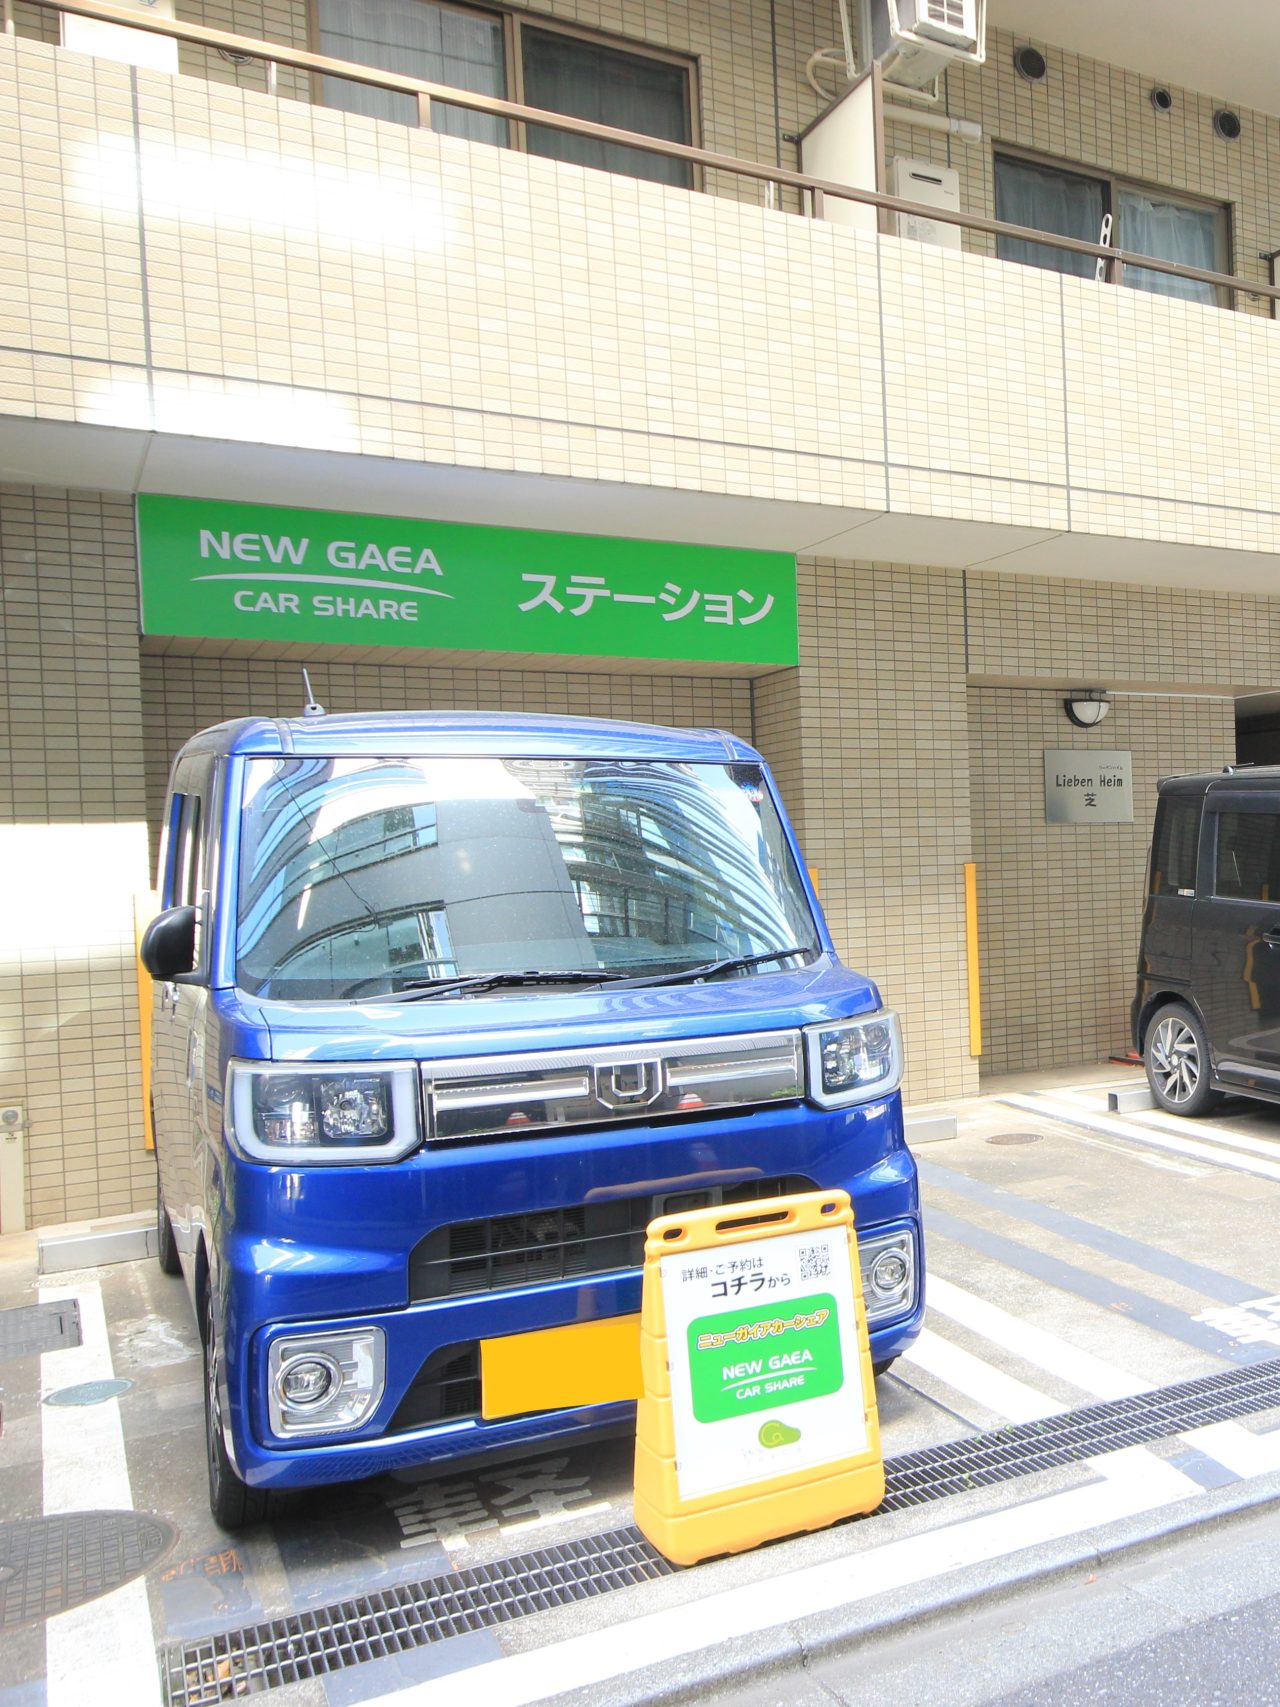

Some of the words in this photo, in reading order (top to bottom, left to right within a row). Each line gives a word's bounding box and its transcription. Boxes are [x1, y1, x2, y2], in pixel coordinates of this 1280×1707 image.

[199, 529, 309, 565] NEW
[326, 541, 443, 576] GAEA
[233, 590, 300, 614] CAR
[312, 595, 418, 621] SHARE
[518, 573, 774, 626] ステーション
[1056, 774, 1093, 788] Lieben
[1099, 774, 1123, 788] Heim
[1084, 792, 1097, 807] 芝
[711, 1272, 791, 1298] コチラから
[698, 1309, 829, 1350] ニューガイアカーシェア
[722, 1359, 763, 1381] NEW
[768, 1349, 813, 1369] GAEA
[735, 1385, 761, 1400] CAR
[764, 1375, 805, 1393] SHARE
